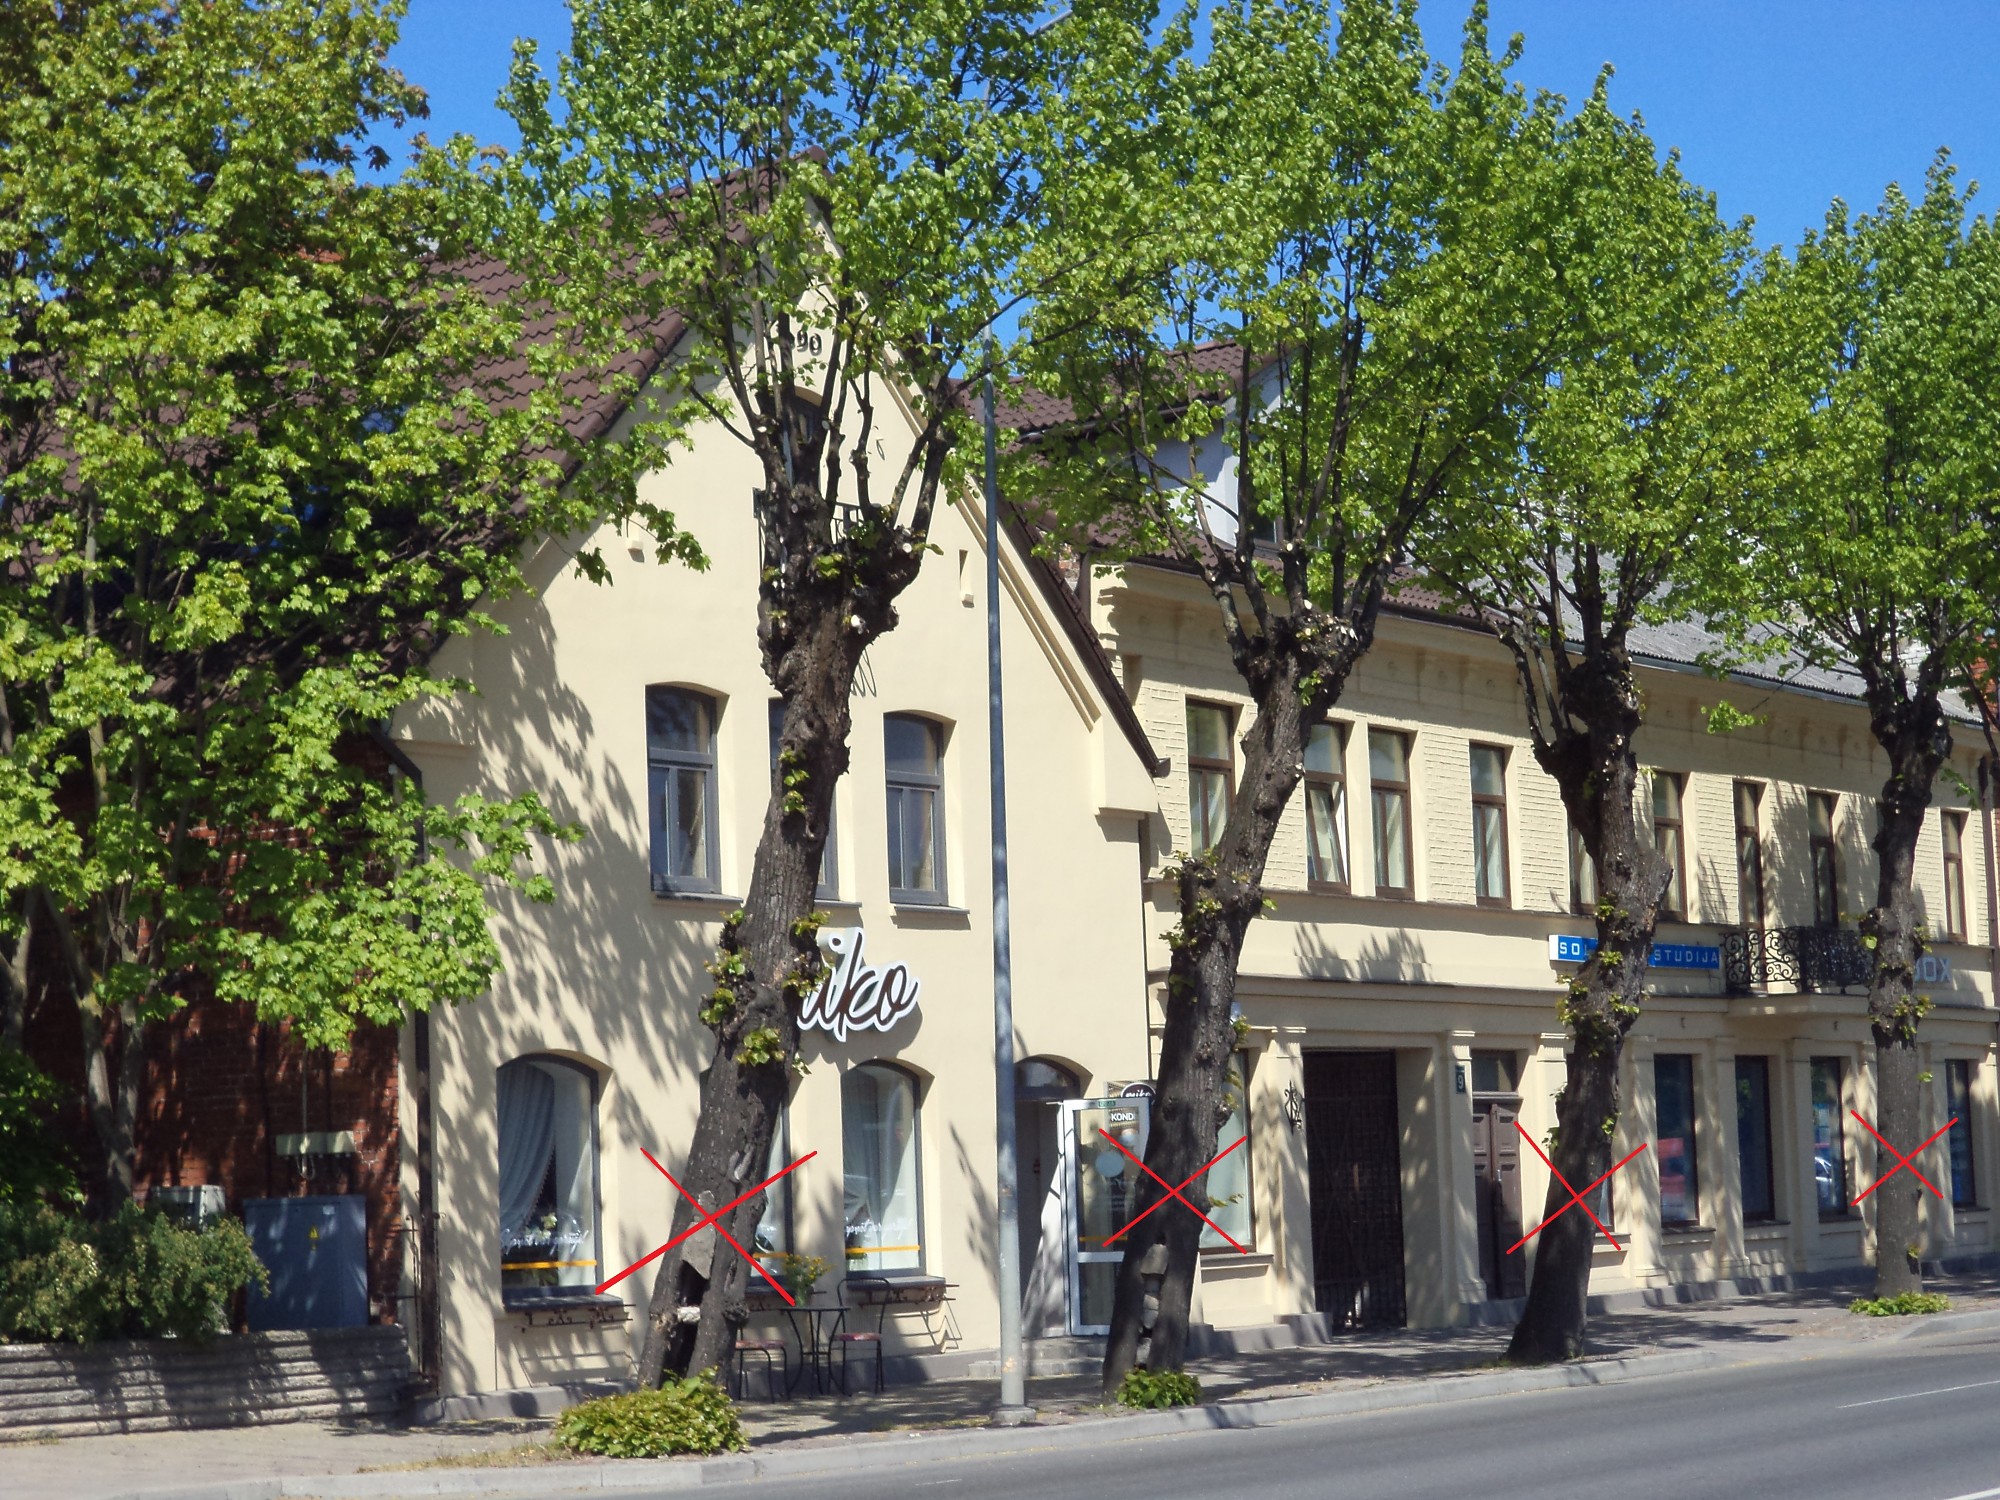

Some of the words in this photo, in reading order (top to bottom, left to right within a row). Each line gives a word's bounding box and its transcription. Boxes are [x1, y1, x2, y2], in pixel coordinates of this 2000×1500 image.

[1654, 949, 1719, 964] STUDIJA
[797, 928, 920, 1041] iko
[1457, 1074, 1464, 1089] 9
